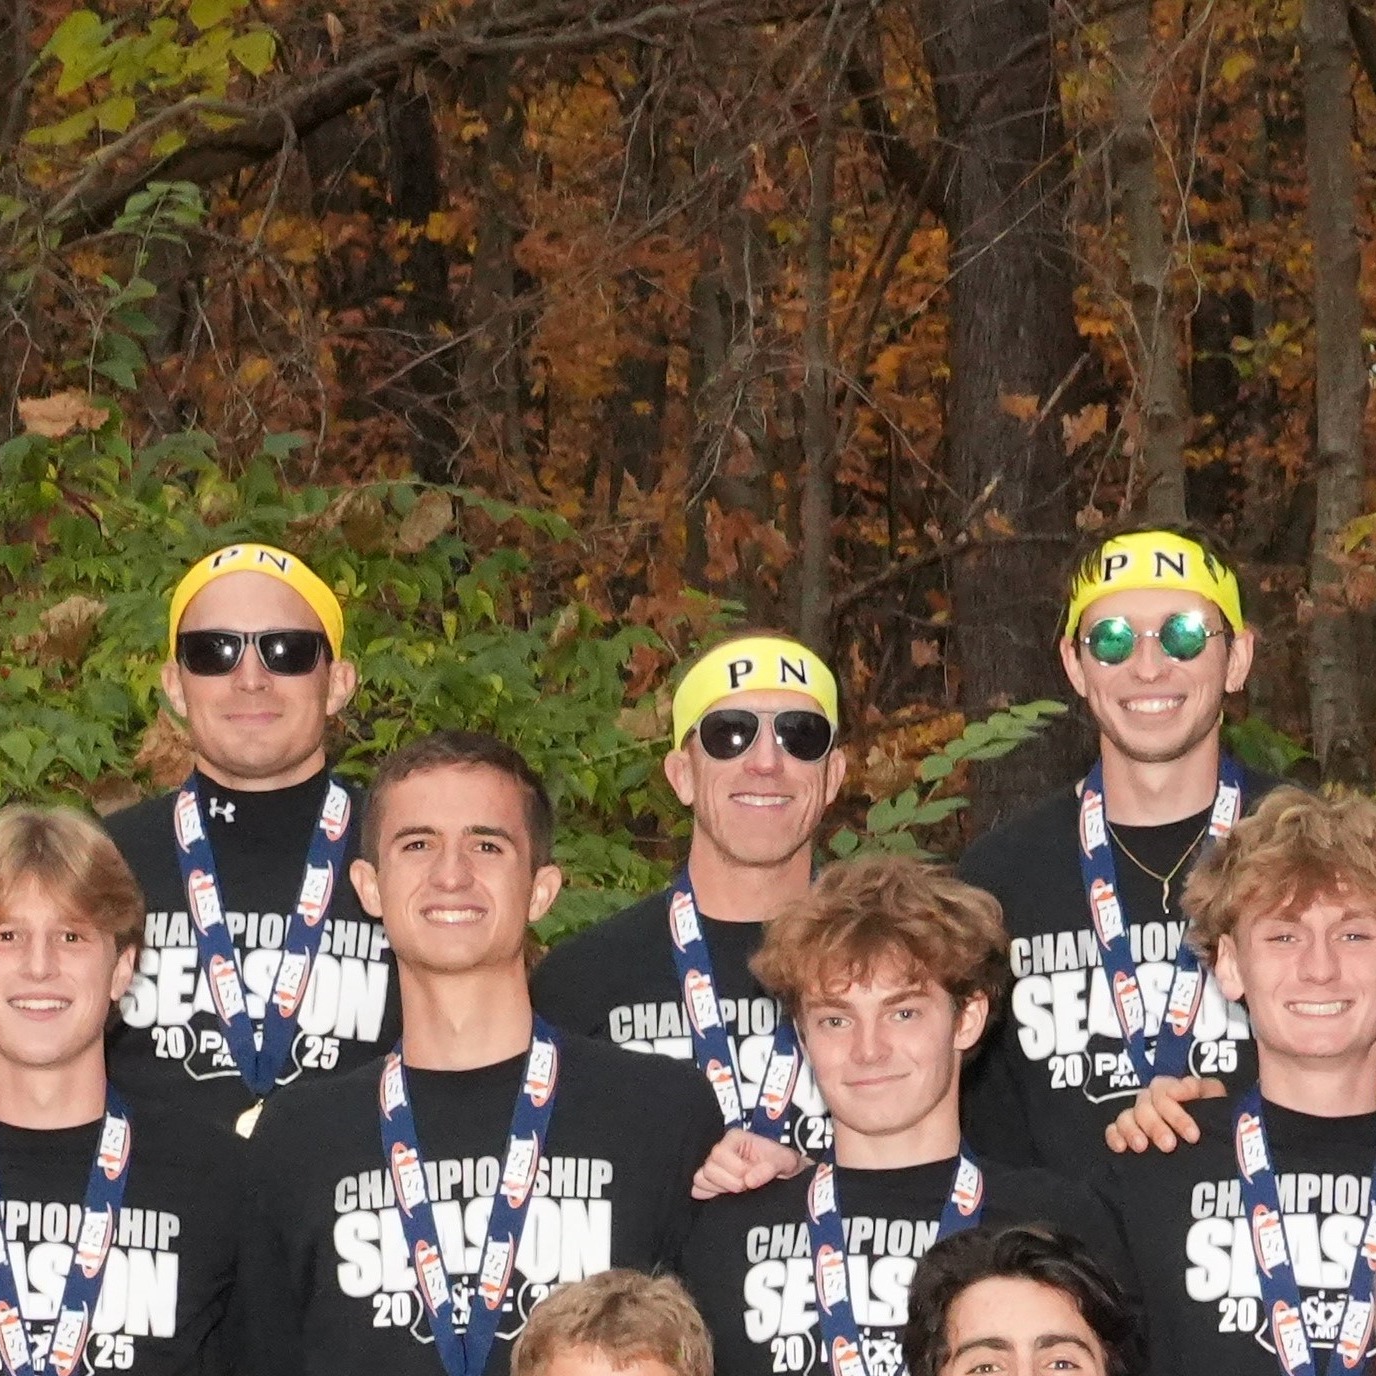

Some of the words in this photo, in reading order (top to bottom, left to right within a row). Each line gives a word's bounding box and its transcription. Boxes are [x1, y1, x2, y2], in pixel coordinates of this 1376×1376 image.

[151, 1026, 186, 1059] 20
[302, 1036, 340, 1069] 25
[1048, 1054, 1083, 1088] 20
[1200, 1041, 1238, 1073] 25
[373, 1292, 412, 1327] 20
[1218, 1297, 1257, 1333] 20
[94, 1335, 135, 1369] 25
[770, 1336, 805, 1373] 20
